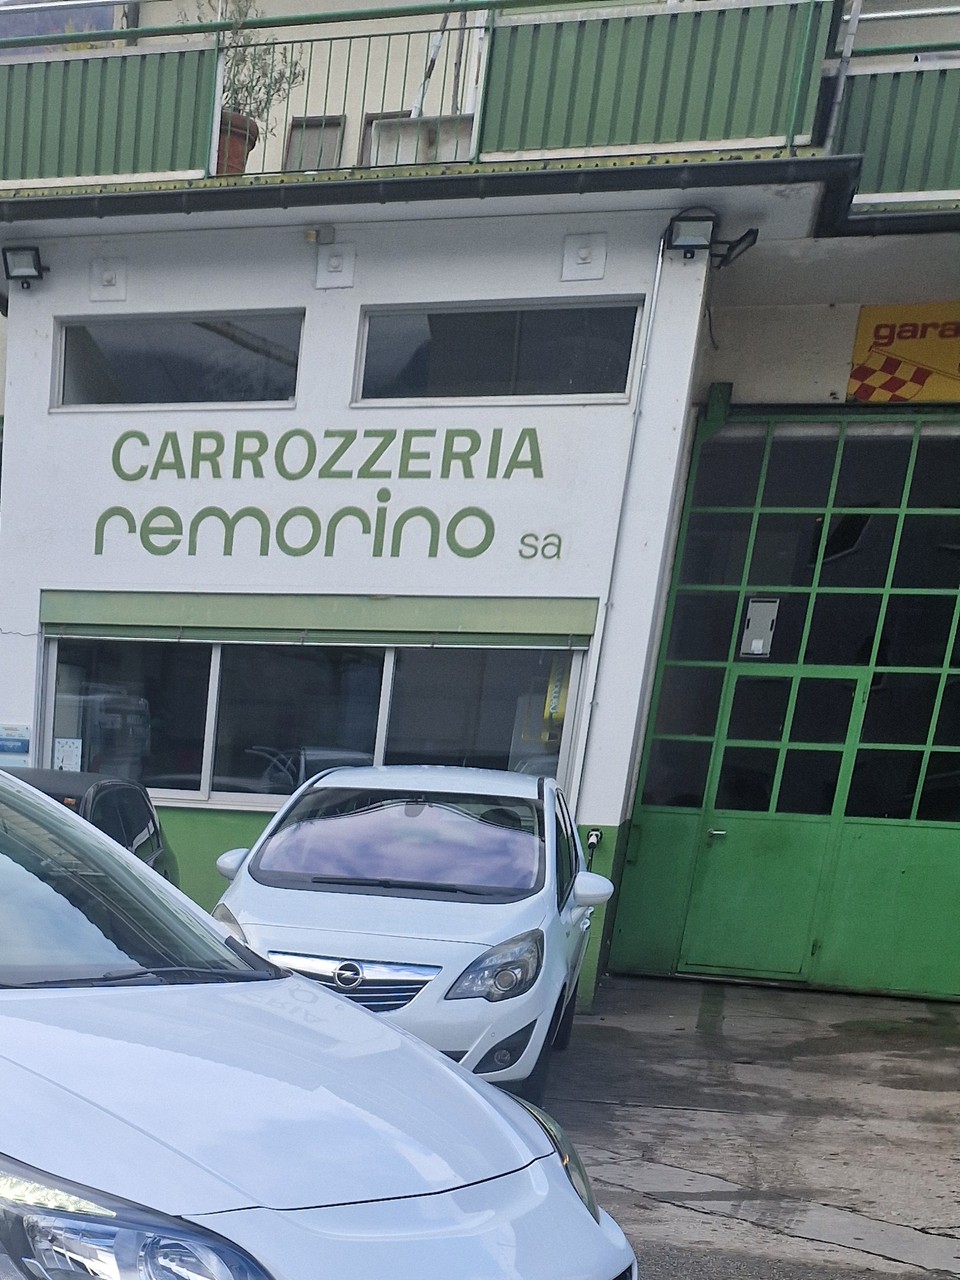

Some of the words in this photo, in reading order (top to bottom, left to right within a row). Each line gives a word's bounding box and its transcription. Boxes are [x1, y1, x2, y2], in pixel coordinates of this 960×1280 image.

[112, 427, 544, 481] CARROZZERIA
[94, 487, 495, 558] remorino
[518, 532, 562, 560] sa
